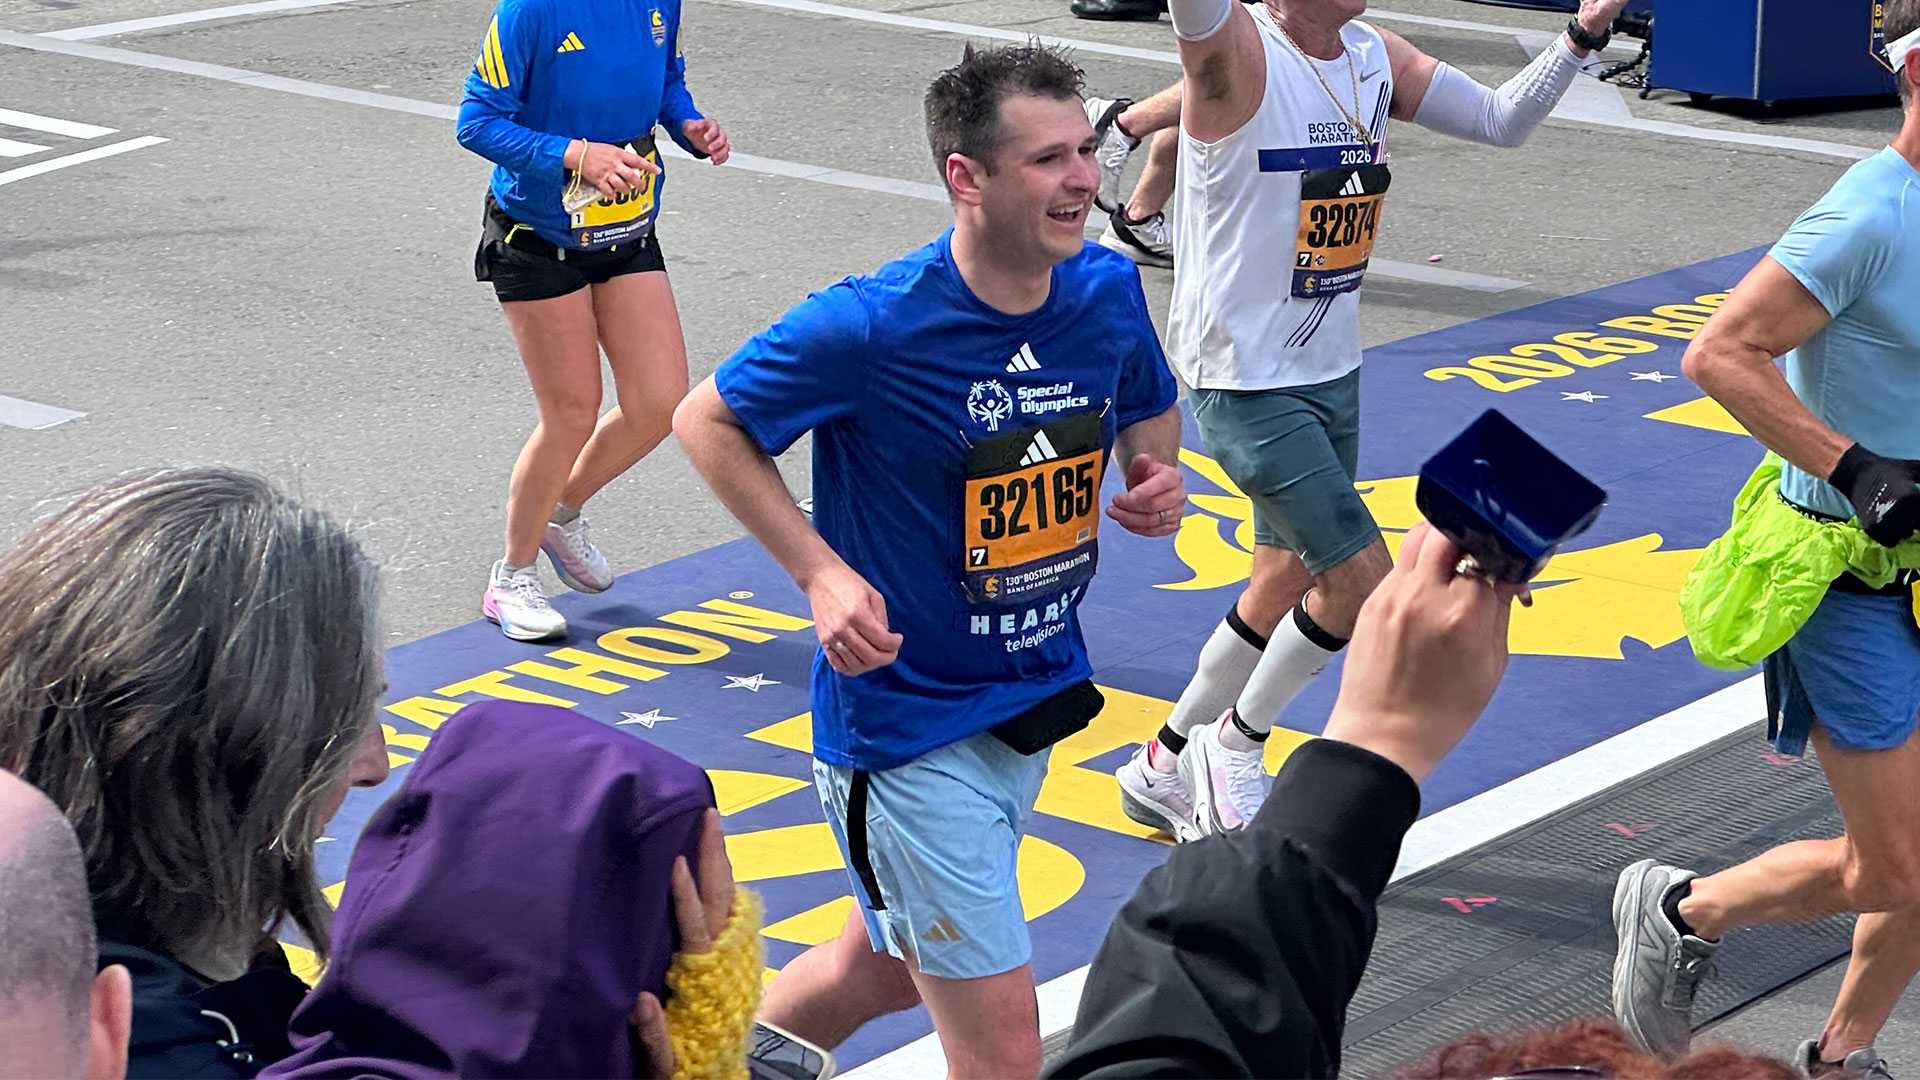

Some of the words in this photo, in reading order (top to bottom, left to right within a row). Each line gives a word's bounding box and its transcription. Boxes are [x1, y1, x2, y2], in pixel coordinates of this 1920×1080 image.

[1340, 149, 1372, 165] 2026
[575, 213, 581, 224] 1
[1307, 201, 1377, 248] 32874
[1299, 253, 1310, 266] 7
[1423, 331, 1659, 393] 2026
[1017, 382, 1074, 402] Special
[1020, 396, 1089, 415] Olympics
[980, 460, 1095, 541] 32165
[972, 548, 986, 565] 7
[1023, 565, 1053, 583] BOSTON
[1053, 551, 1090, 574] MARATHON
[1006, 586, 1026, 595] BANK
[1004, 622, 1065, 653] television
